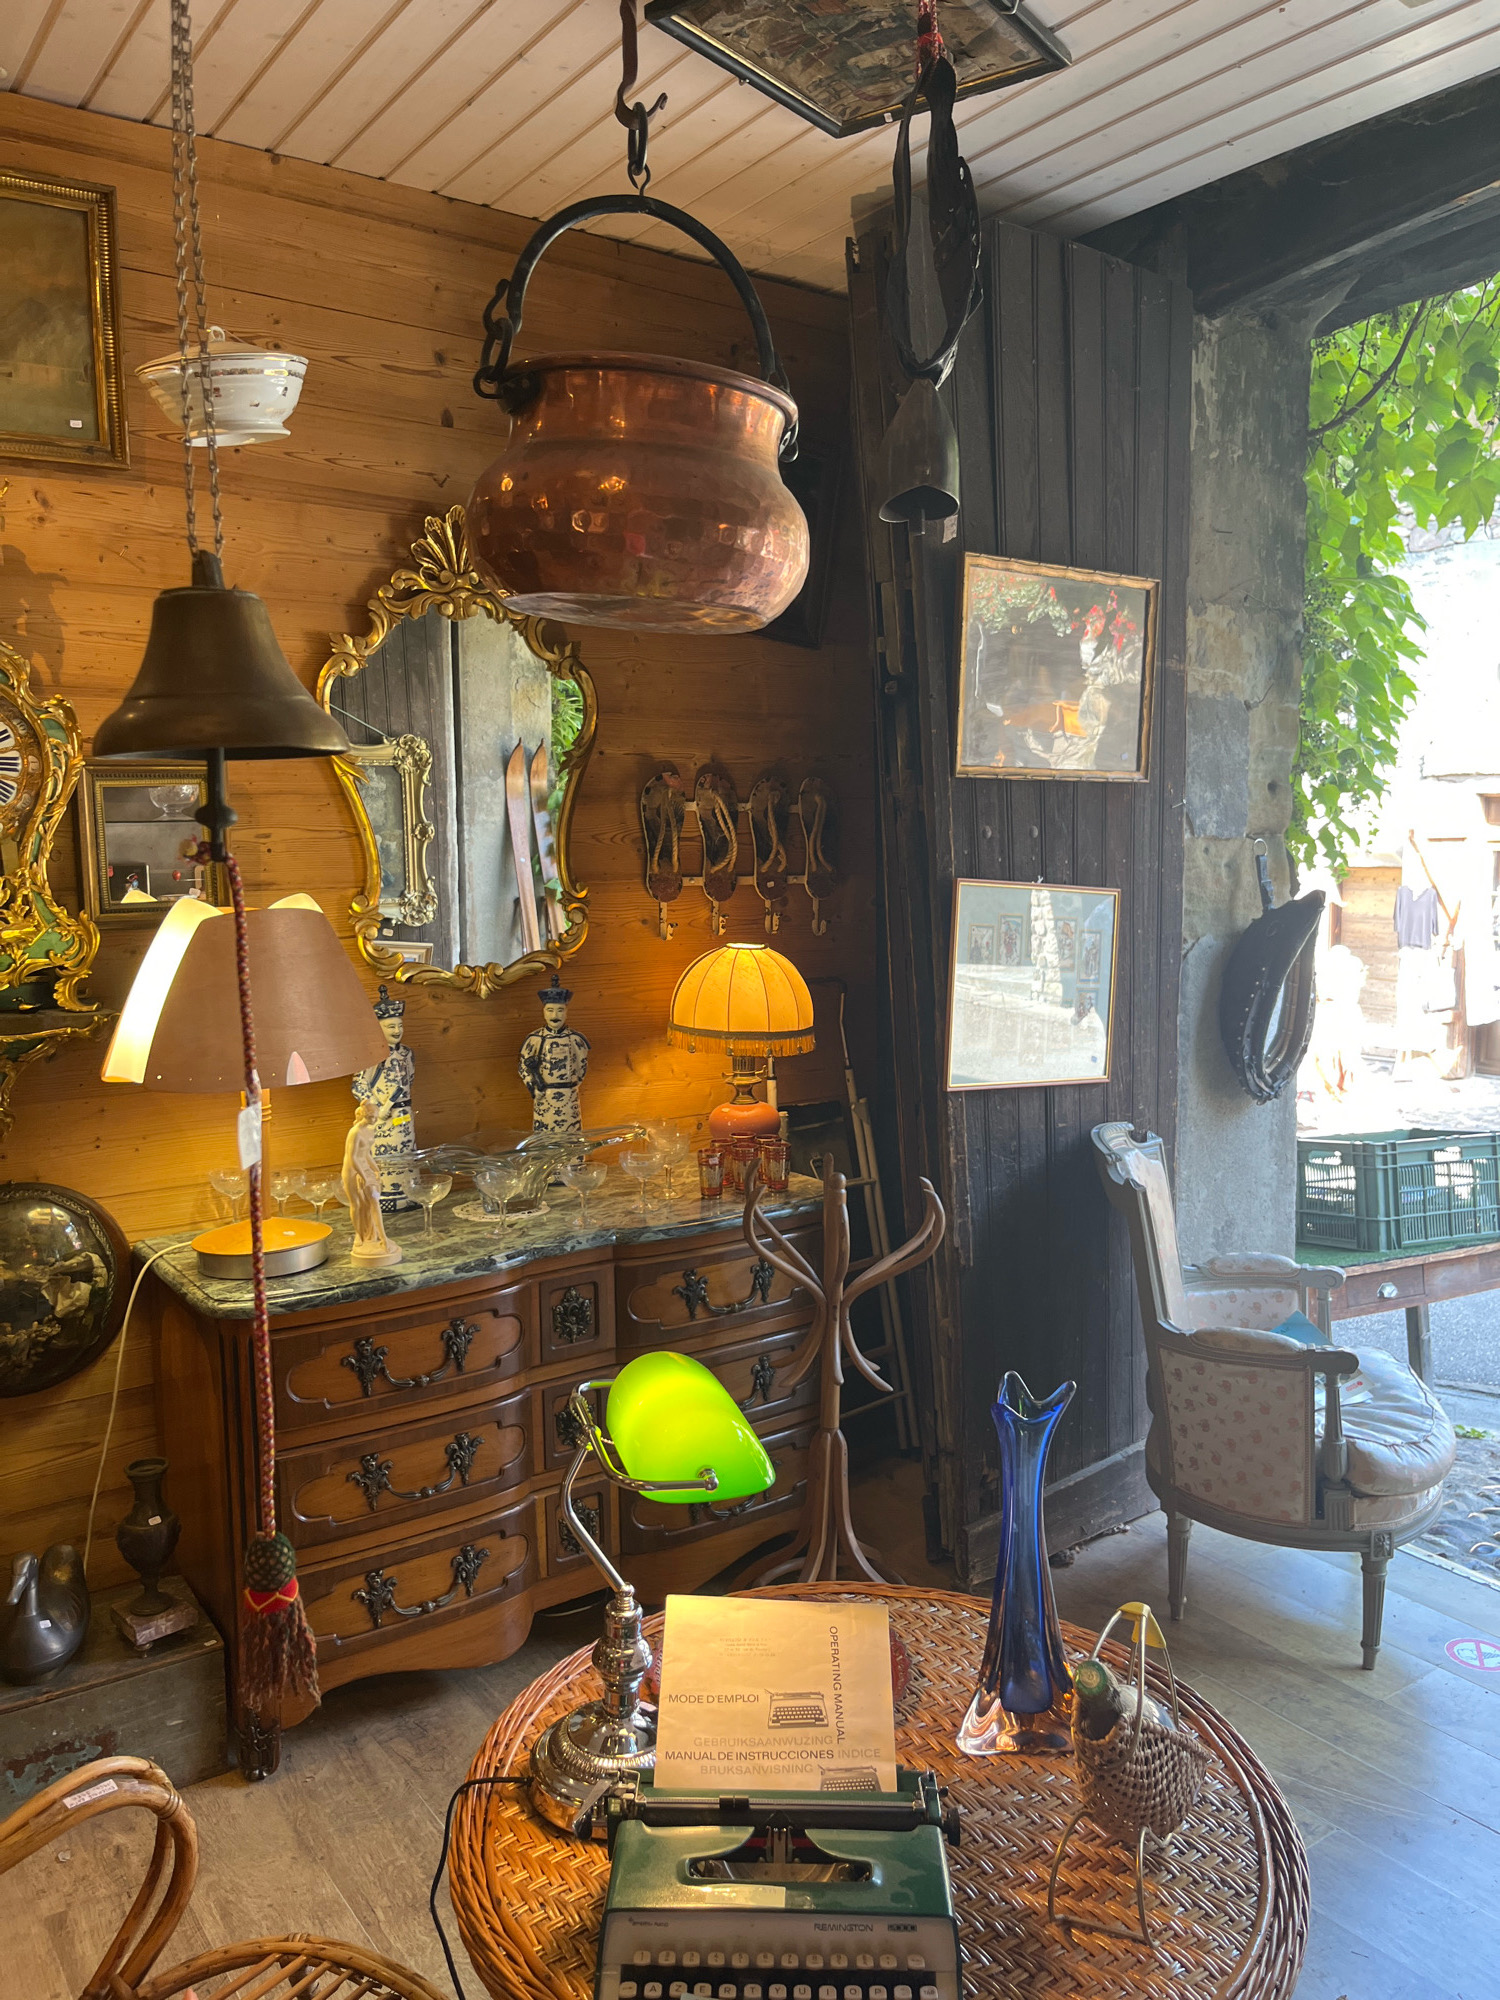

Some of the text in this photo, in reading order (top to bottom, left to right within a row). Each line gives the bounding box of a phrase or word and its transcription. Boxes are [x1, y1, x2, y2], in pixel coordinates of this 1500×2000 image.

[829, 1625, 846, 1745] OPERATING MANUAL
[668, 1693, 760, 1704] MODE D'EMPLOI
[664, 1748, 881, 1761] MANUAL DE INSTRUCCIONES INDICE
[700, 1763, 813, 1776] BRUKSANVISNING
[813, 1922, 874, 1933] REMINGTON
